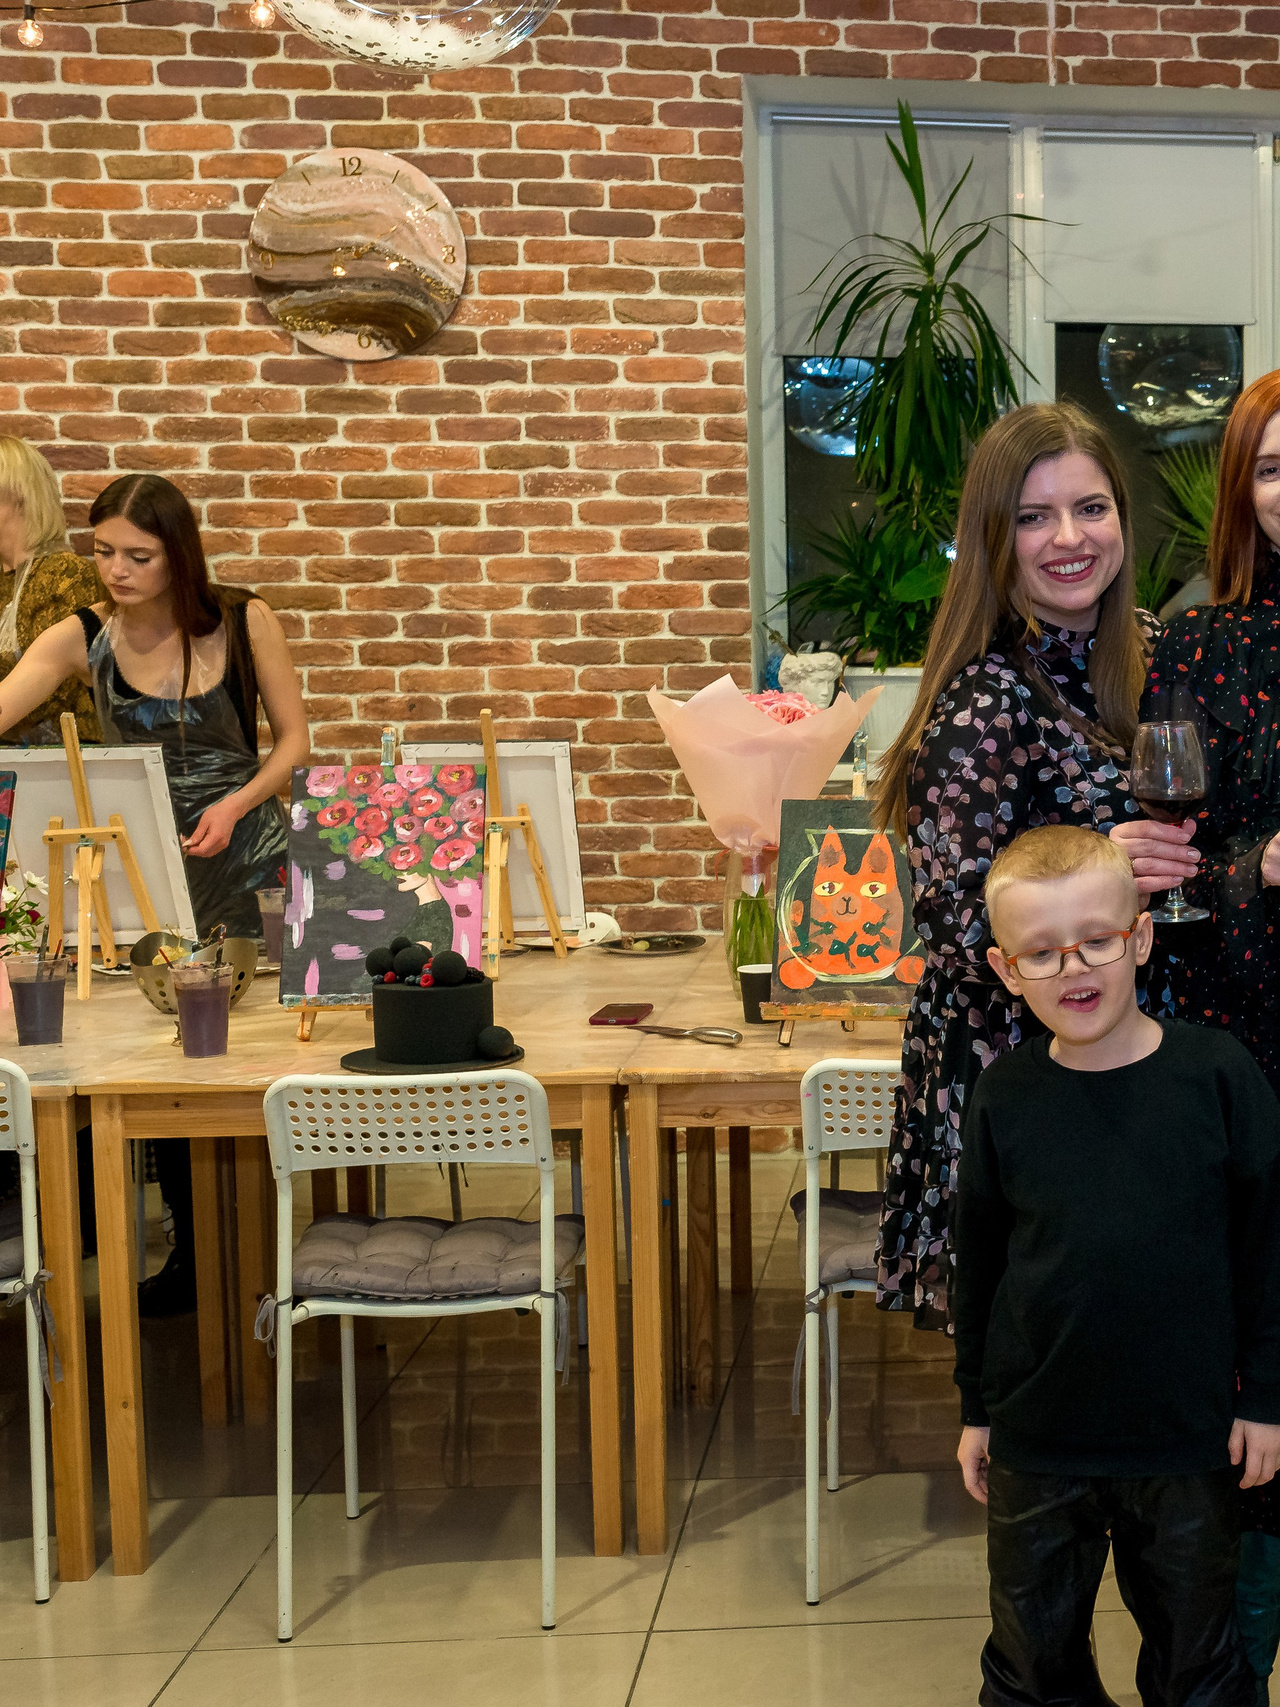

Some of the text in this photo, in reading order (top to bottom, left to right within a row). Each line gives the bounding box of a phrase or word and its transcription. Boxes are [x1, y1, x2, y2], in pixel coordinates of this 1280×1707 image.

[338, 156, 363, 177] 12
[259, 250, 275, 270] 9
[357, 329, 371, 349] 6
